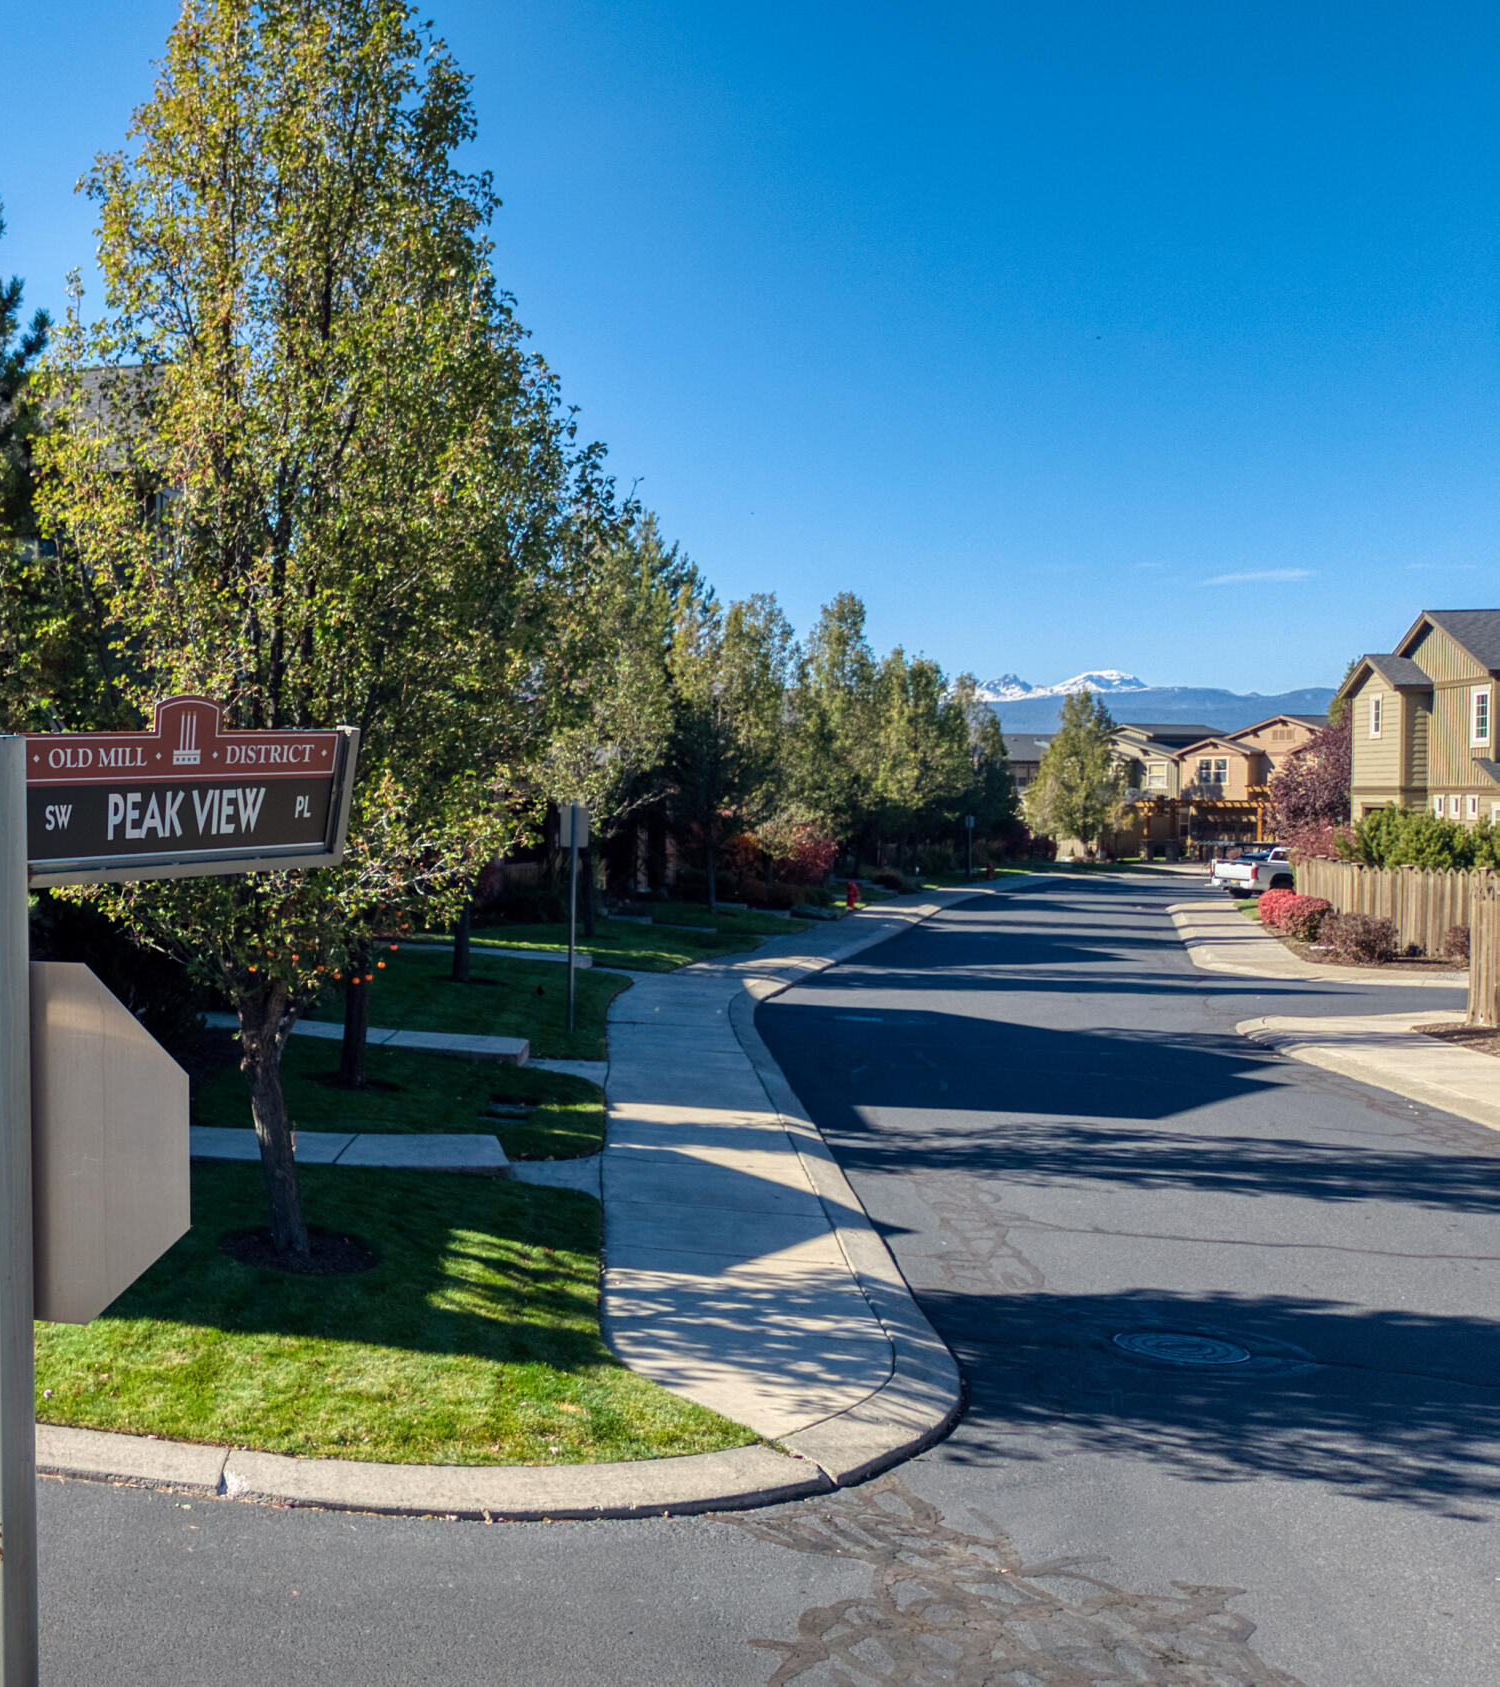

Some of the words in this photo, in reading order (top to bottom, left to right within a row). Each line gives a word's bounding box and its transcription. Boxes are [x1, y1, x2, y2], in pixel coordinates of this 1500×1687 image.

[48, 748, 93, 768] OLD
[98, 746, 148, 767] MILL
[225, 744, 315, 765] DISTRICT
[44, 804, 73, 831] SW
[107, 790, 185, 841] PEAK
[192, 787, 266, 836] VIEW
[294, 795, 312, 819] PL
